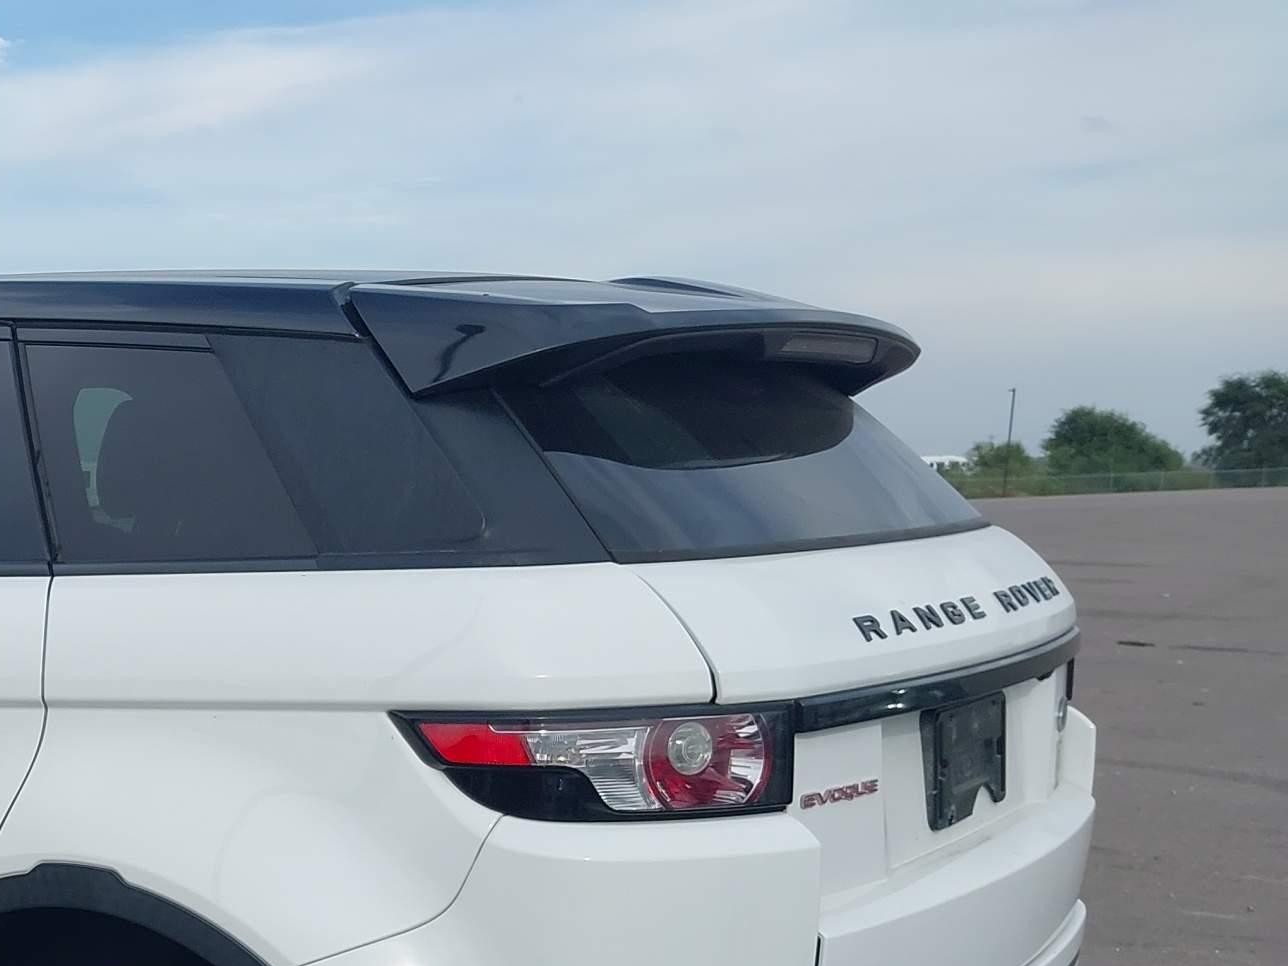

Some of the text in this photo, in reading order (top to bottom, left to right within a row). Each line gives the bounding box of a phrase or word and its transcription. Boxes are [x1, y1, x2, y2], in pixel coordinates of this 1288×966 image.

[852, 576, 1060, 643] RANGE ROVER
[800, 779, 879, 810] EVOQUE
